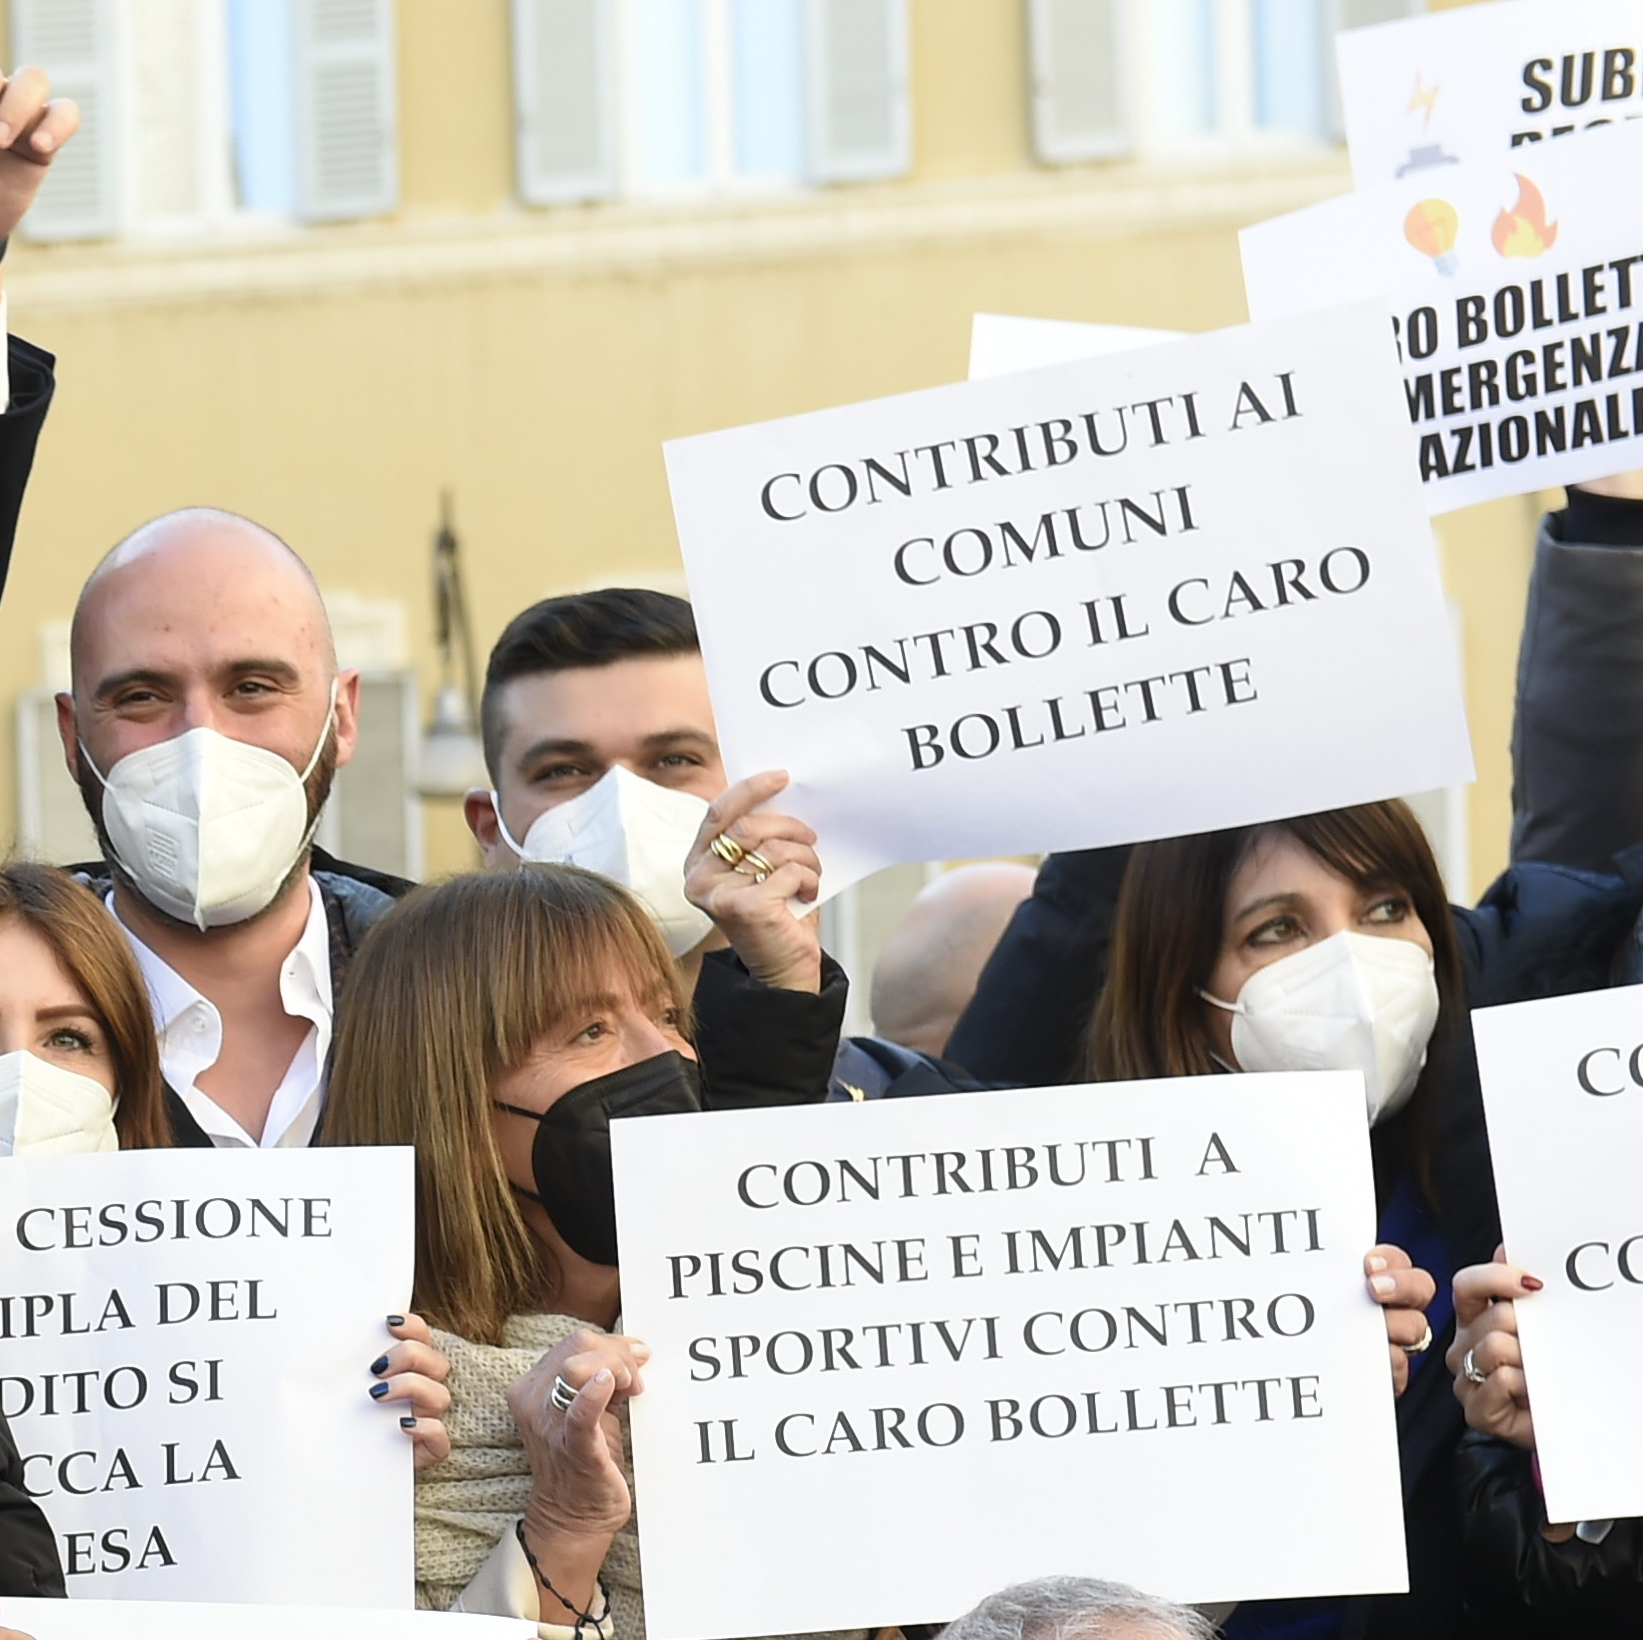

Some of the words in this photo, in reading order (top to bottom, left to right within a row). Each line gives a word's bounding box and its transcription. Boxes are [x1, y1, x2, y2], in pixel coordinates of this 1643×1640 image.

[1522, 48, 1643, 113] SUB
[1456, 254, 1643, 349] BOLLET
[761, 392, 1205, 521] CONTRIBUTI
[1229, 372, 1302, 431] AI
[893, 485, 1196, 586] COMUNI
[759, 610, 1062, 708] CONTRO
[1082, 594, 1150, 646] IL
[1167, 546, 1371, 626] CARO
[902, 657, 1258, 771] BOLLETTE
[737, 1137, 1156, 1209] CONTRIBUTI
[1194, 1131, 1242, 1177] A
[16, 1197, 332, 1252] CESSIONE
[665, 1238, 929, 1300] PISCINE
[946, 1233, 983, 1279] E
[1001, 1208, 1325, 1275] IMPIANTI
[154, 1279, 277, 1326] DEL
[688, 1316, 1003, 1382] SPORTIVI
[1023, 1293, 1315, 1356] CONTRO
[168, 1359, 224, 1405] SI
[693, 1418, 756, 1465] IL
[774, 1402, 965, 1458] CARO
[984, 1375, 1323, 1442] BOLLETTE
[160, 1439, 242, 1486] LA
[62, 1525, 178, 1576] ESA
